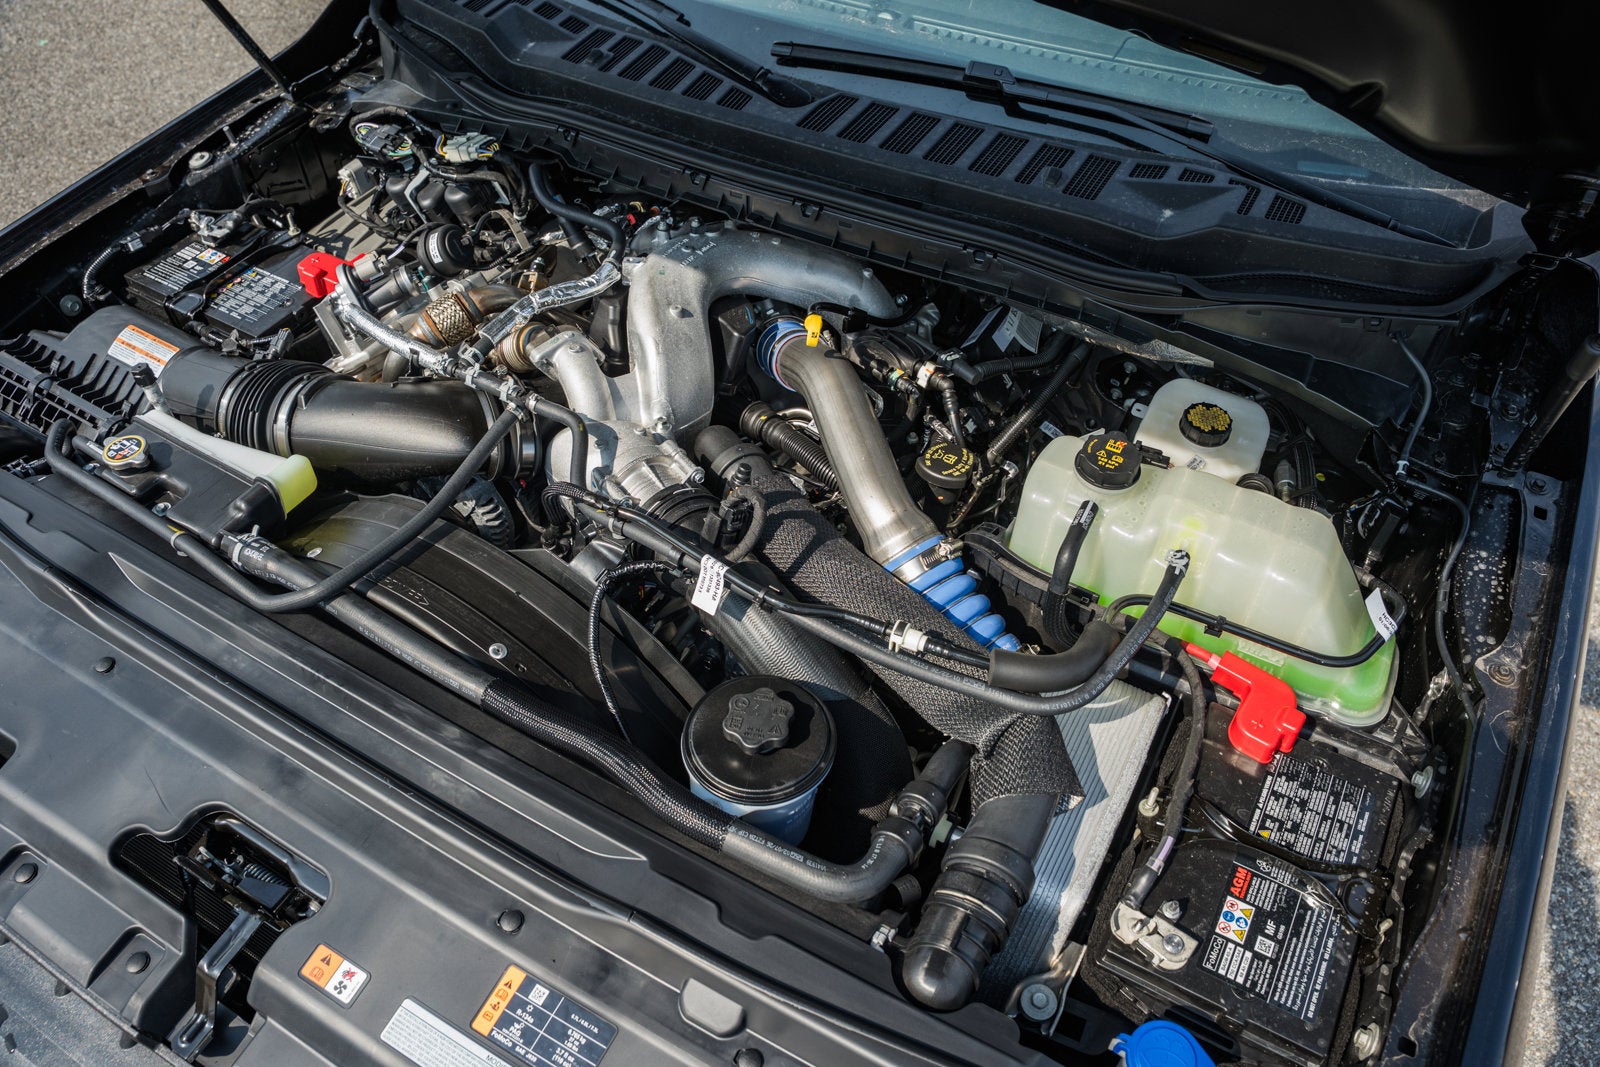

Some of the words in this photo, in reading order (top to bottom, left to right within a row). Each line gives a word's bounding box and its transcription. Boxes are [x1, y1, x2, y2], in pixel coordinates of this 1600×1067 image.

[1229, 866, 1247, 896] AGM
[1265, 918, 1277, 935] MF
[1205, 937, 1222, 968] FoMoCo
[515, 1009, 534, 1023] R-134a
[490, 1029, 513, 1047] FoMoCo
